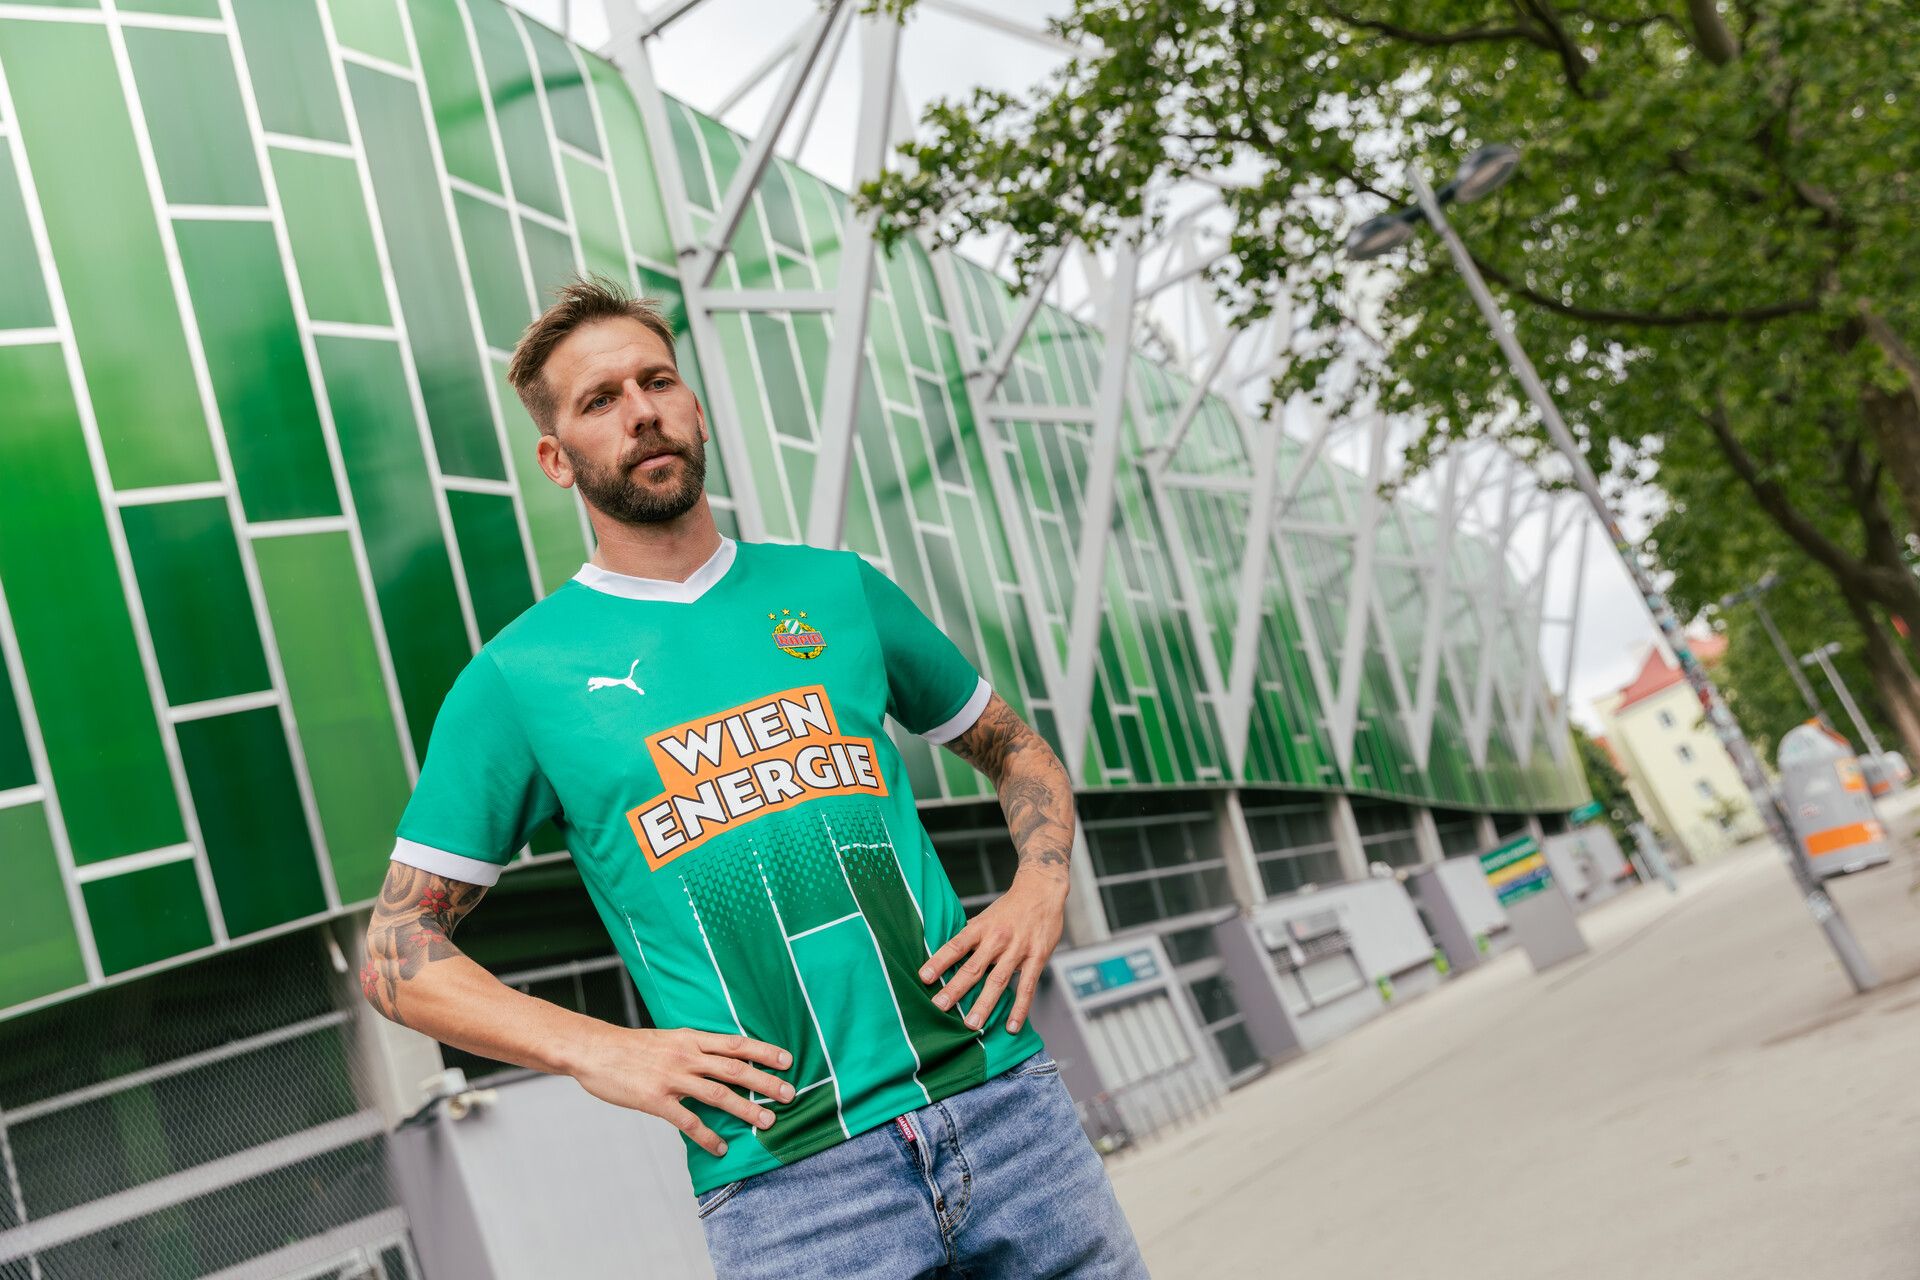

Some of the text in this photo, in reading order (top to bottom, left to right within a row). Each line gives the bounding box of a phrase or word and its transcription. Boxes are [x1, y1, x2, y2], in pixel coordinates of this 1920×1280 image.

[777, 633, 821, 645] RAPID
[657, 692, 832, 776] WIEN
[638, 743, 879, 859] ENERGIE
